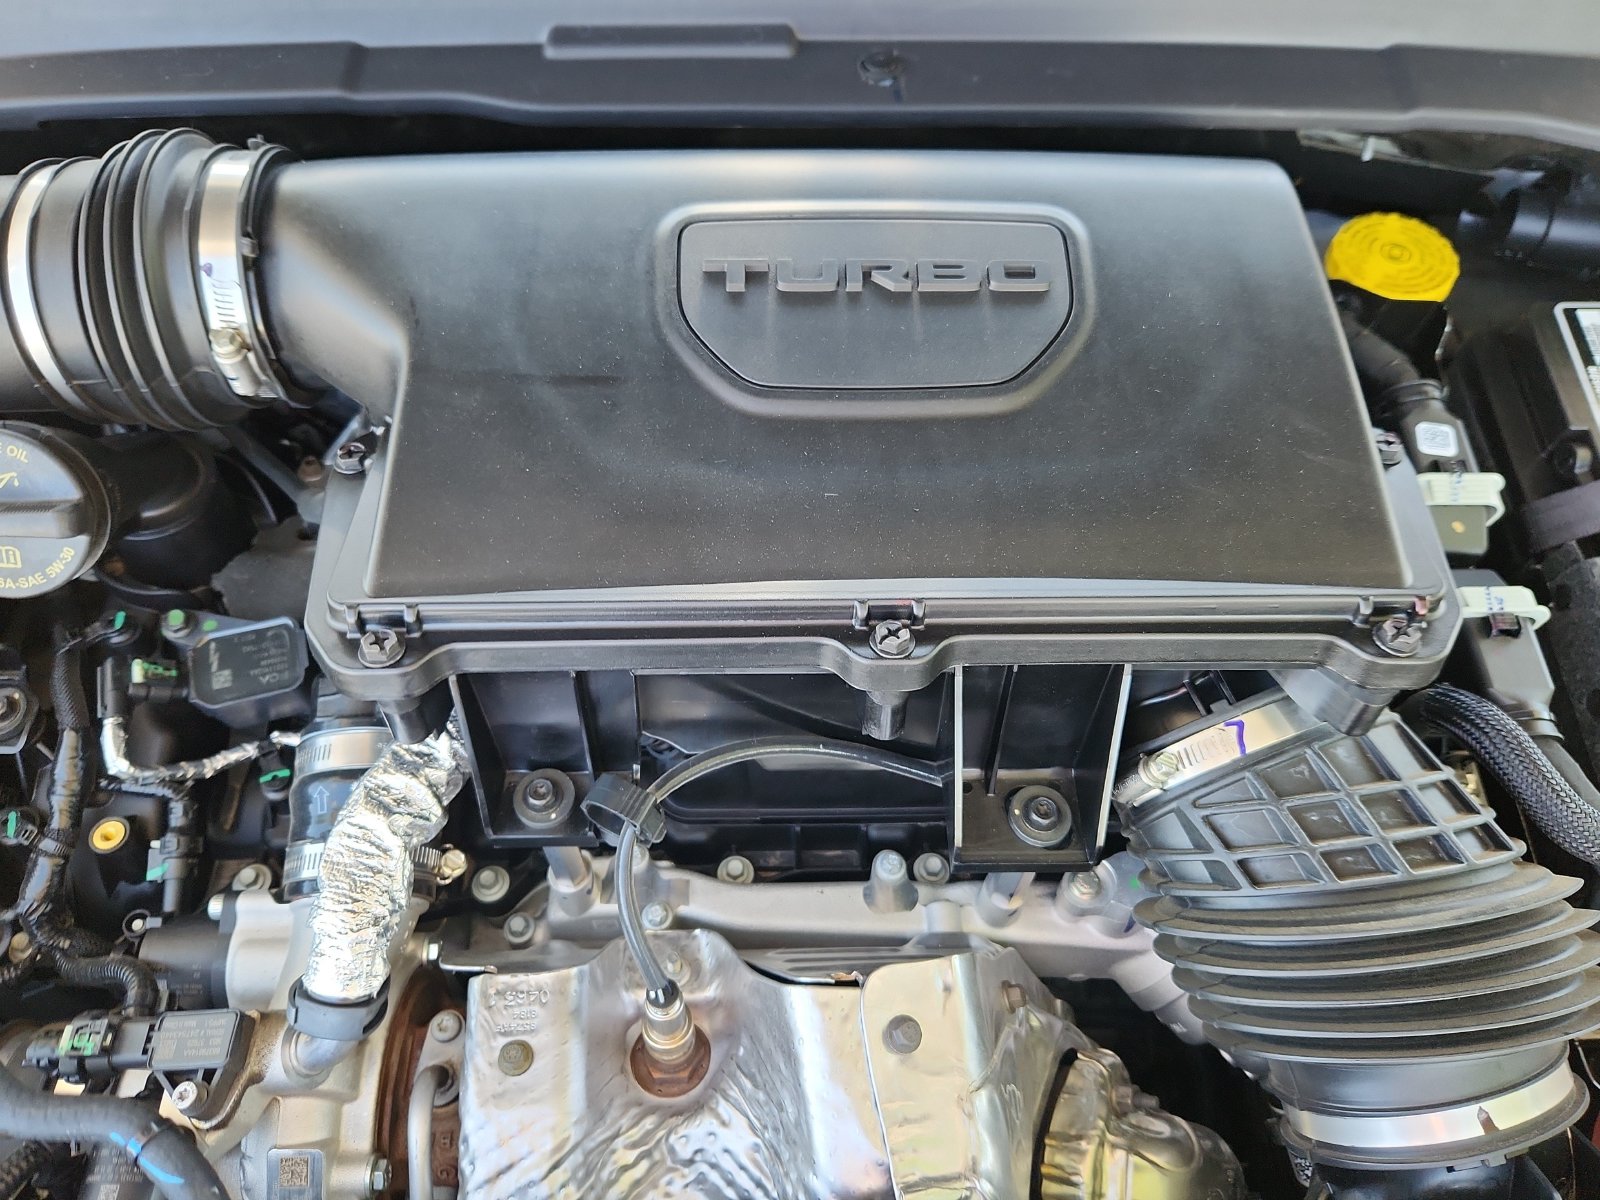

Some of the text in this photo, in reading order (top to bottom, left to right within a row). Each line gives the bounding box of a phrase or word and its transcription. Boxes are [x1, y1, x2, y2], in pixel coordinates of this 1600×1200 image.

[702, 258, 1051, 293] TURBO
[6, 445, 29, 464] OIL
[45, 546, 75, 578] 5W-30
